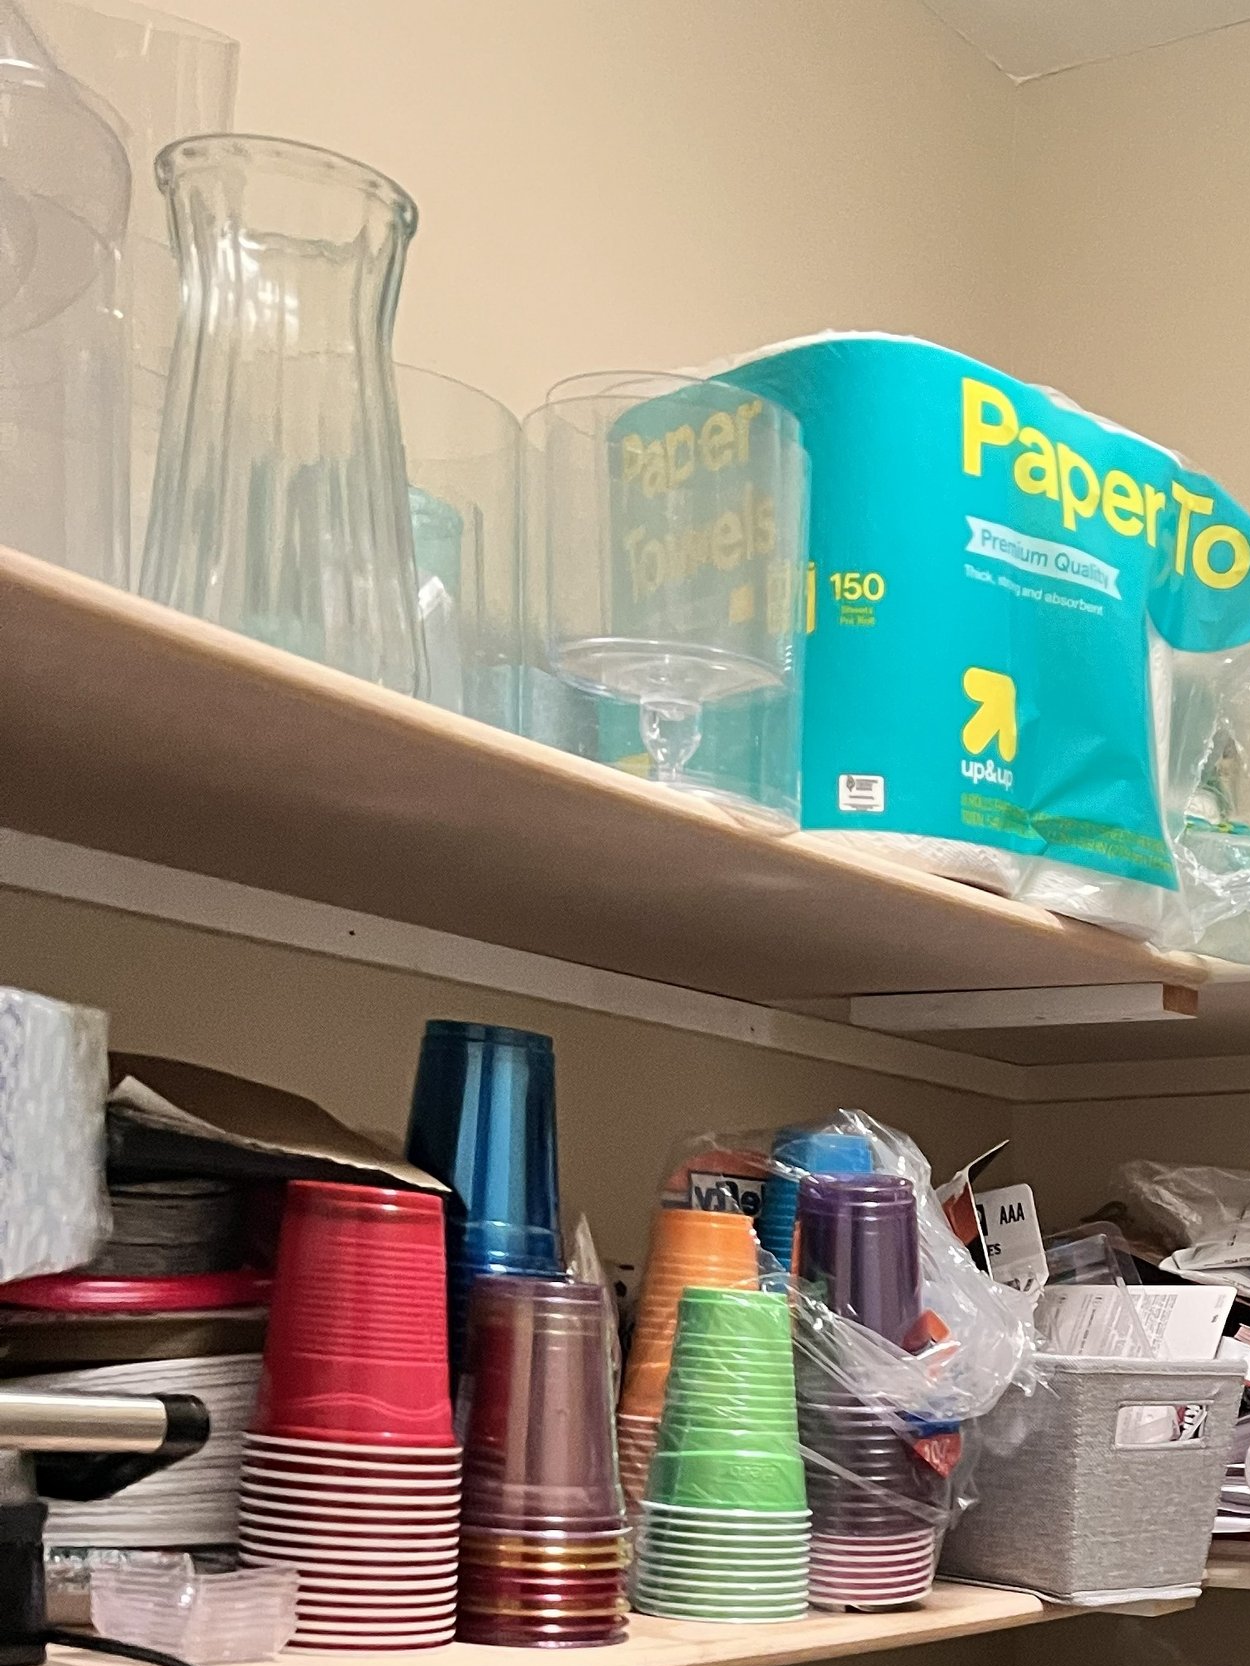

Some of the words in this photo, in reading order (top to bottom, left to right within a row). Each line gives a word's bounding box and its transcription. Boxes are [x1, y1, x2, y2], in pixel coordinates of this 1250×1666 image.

[962, 377, 1166, 547] Paper
[980, 529, 1049, 568] Premium
[1054, 552, 1110, 588] Quality
[830, 573, 885, 602] 150
[1044, 591, 1104, 616] absorbent
[961, 759, 1014, 793] up&up
[1000, 1203, 1025, 1225] AAA
